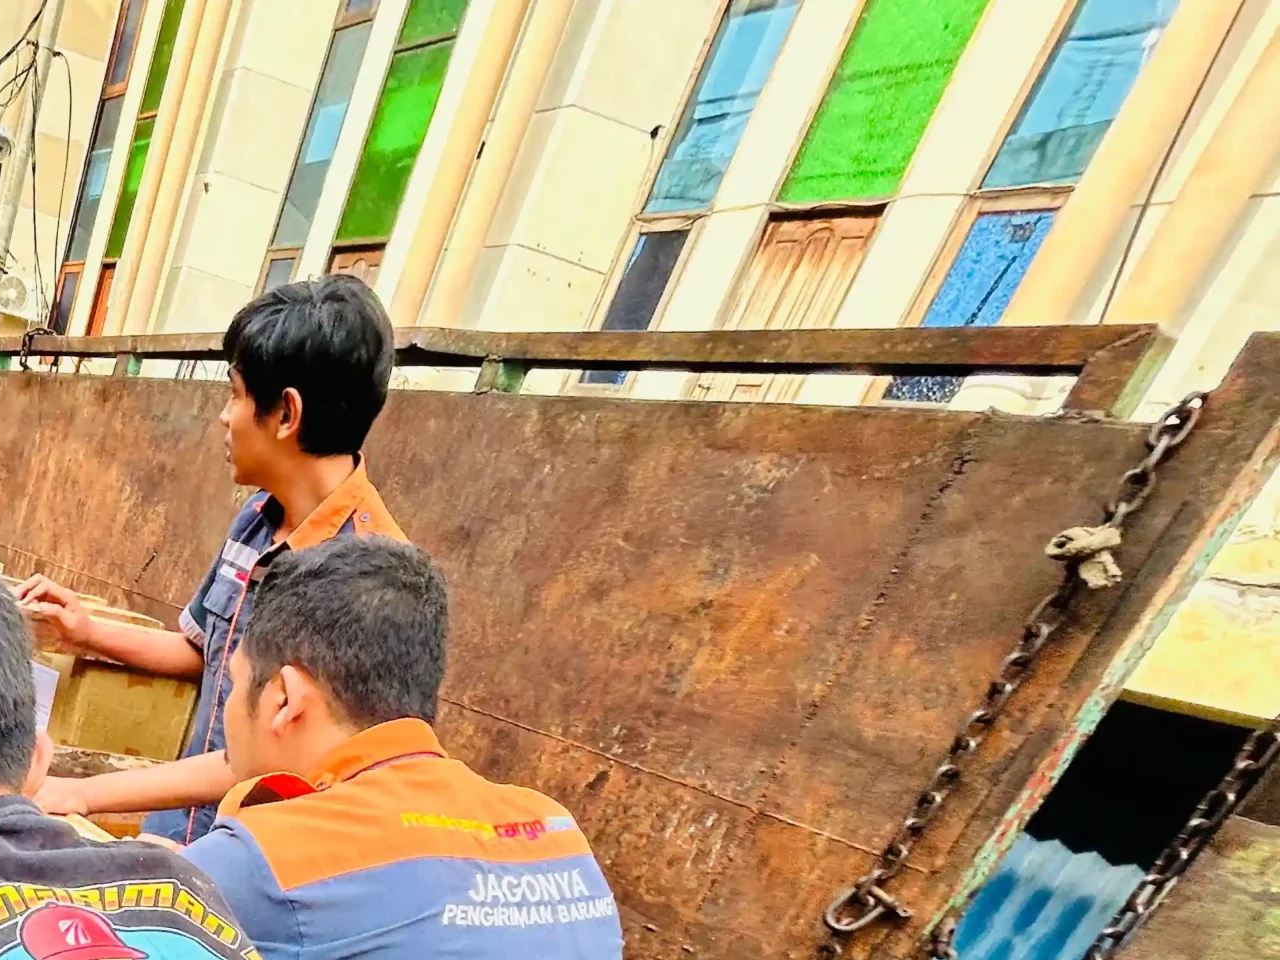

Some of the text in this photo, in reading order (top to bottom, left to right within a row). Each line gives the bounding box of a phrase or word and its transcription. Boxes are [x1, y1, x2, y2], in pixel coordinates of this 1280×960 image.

[468, 868, 590, 902] JAGONYA
[442, 896, 614, 928] PENGIRIMAN BARANG
